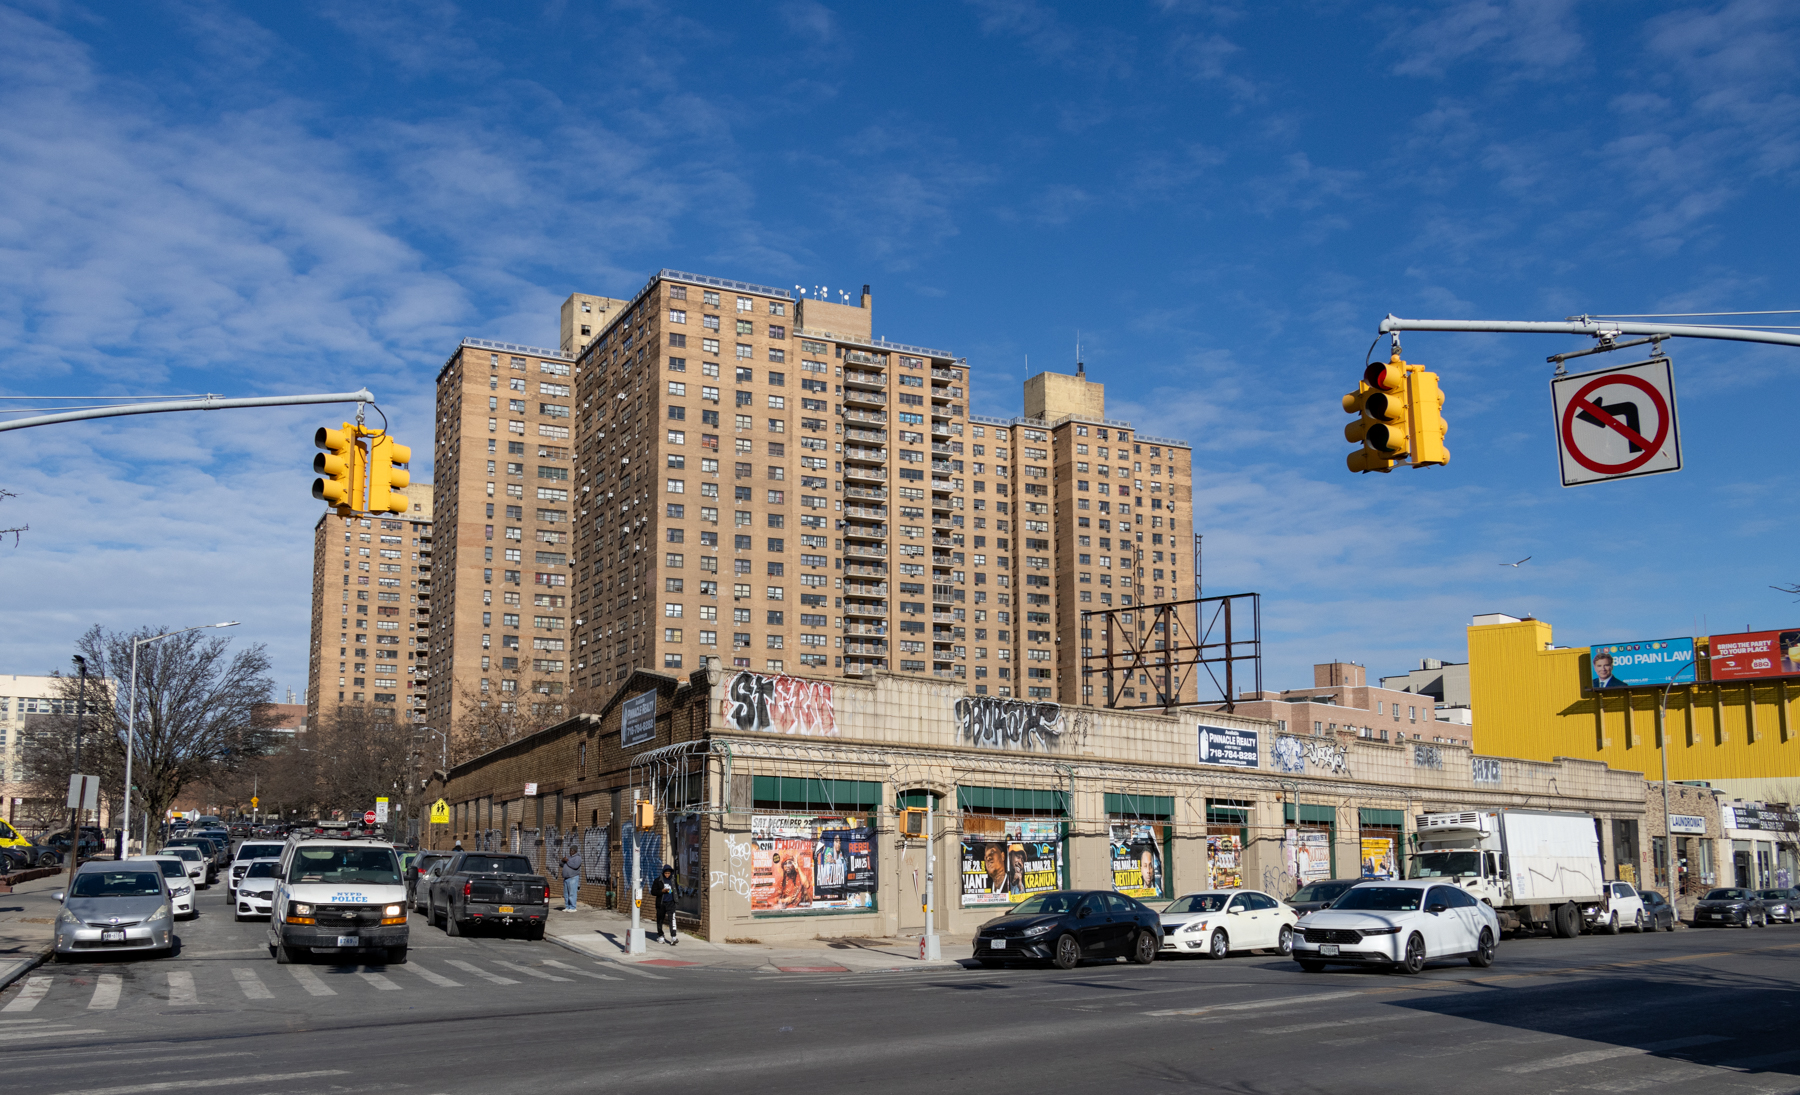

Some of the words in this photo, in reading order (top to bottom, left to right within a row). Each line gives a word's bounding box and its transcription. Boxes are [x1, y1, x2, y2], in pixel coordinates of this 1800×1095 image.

[1595, 644, 1641, 655] INJURY
[1644, 642, 1668, 651] LAW
[1750, 640, 1772, 648] PARTY
[1613, 655, 1632, 666] 800
[1634, 652, 1662, 664] PAIN
[1663, 650, 1692, 662] LAW
[1209, 733, 1236, 745] PINNACLE
[1236, 736, 1256, 747] REALTY
[1210, 749, 1257, 760] 718-784-8282
[768, 818, 803, 828] DECEMBER
[1672, 817, 1702, 828] LAUNDROMAT
[848, 842, 871, 853] REBEL
[854, 858, 862, 868] JAN
[862, 857, 868, 867] 25
[816, 863, 845, 886] AMAZURA
[1115, 872, 1130, 887] DEXTA
[1130, 871, 1143, 886] DAPS
[1024, 873, 1057, 889] KRANIUM
